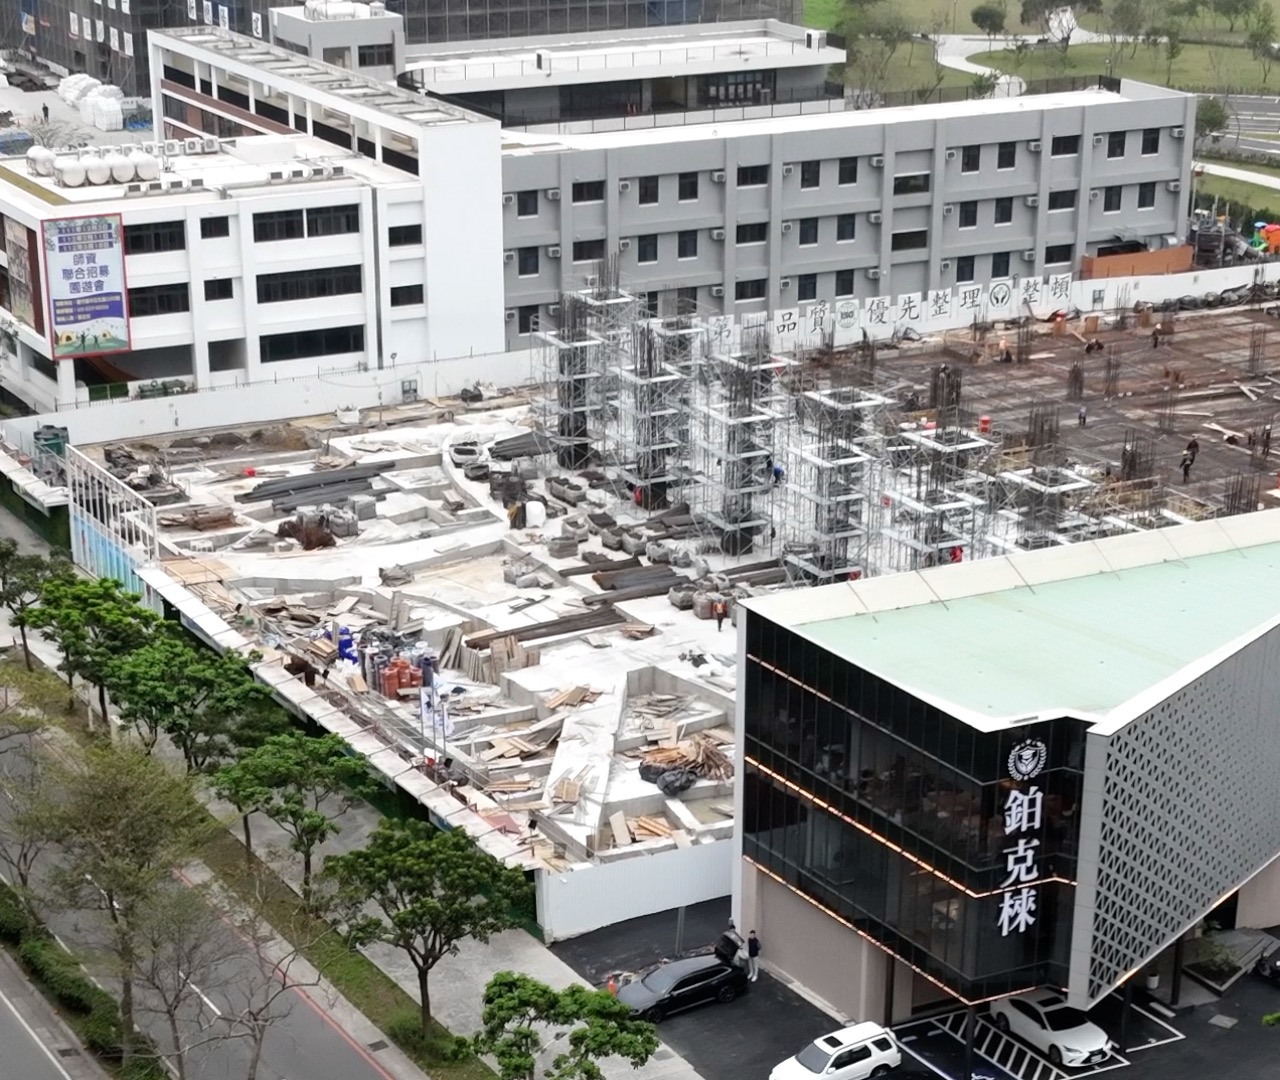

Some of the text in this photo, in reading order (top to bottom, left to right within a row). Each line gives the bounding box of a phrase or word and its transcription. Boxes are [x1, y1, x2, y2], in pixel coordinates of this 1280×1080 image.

[73, 253, 97, 265] 師資
[62, 265, 111, 281] 聯合招募
[841, 310, 854, 319] ISO
